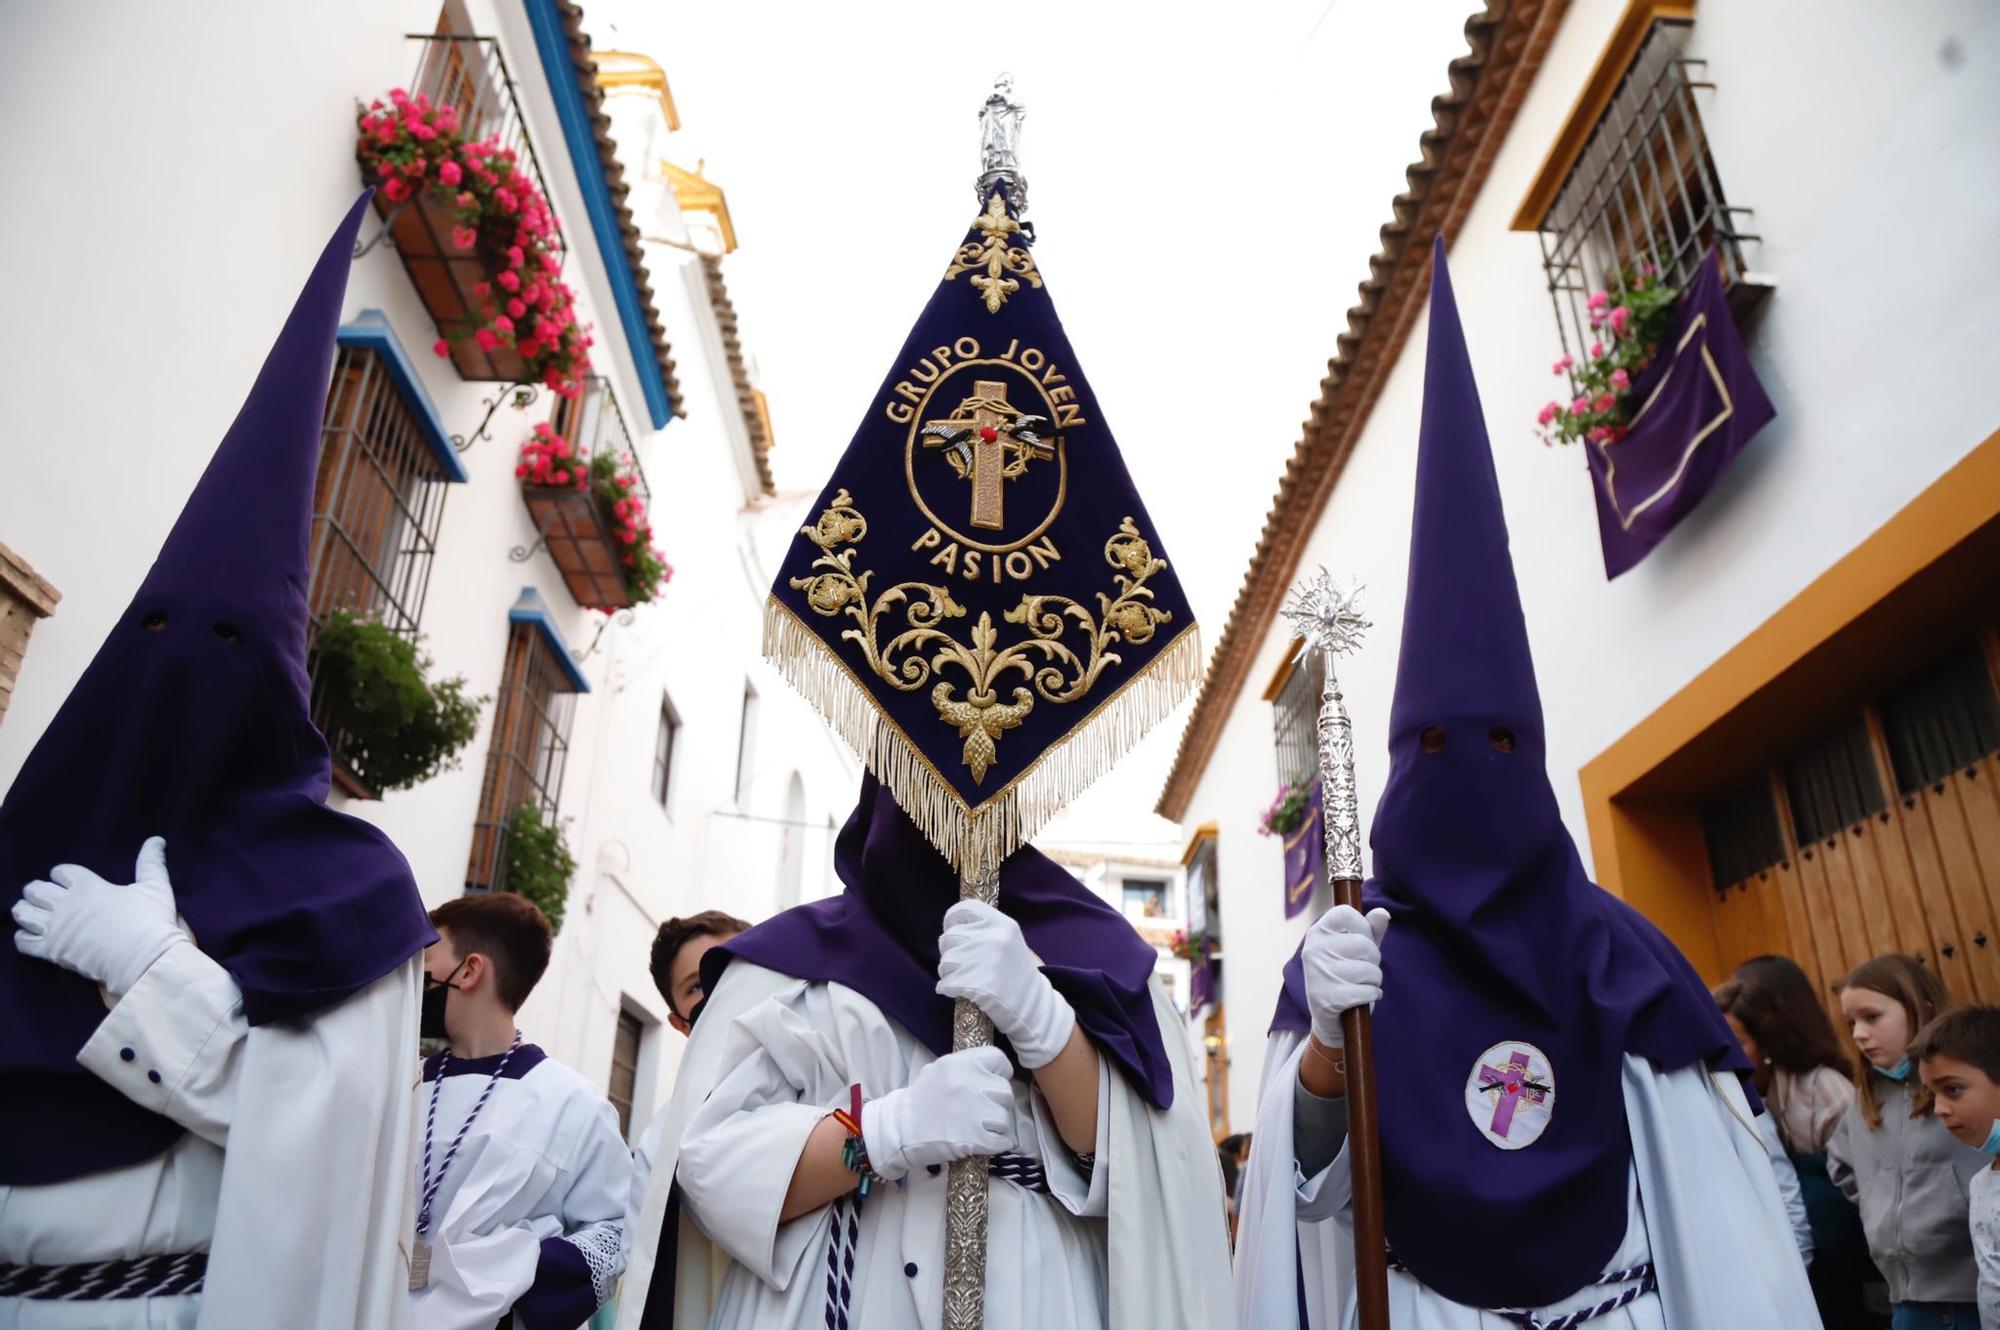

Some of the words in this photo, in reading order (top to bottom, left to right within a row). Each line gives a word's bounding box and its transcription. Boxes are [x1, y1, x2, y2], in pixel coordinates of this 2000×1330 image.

[886, 336, 980, 424] GRUPO
[1000, 338, 1086, 428] JOVEN
[911, 527, 1062, 584] PASION
